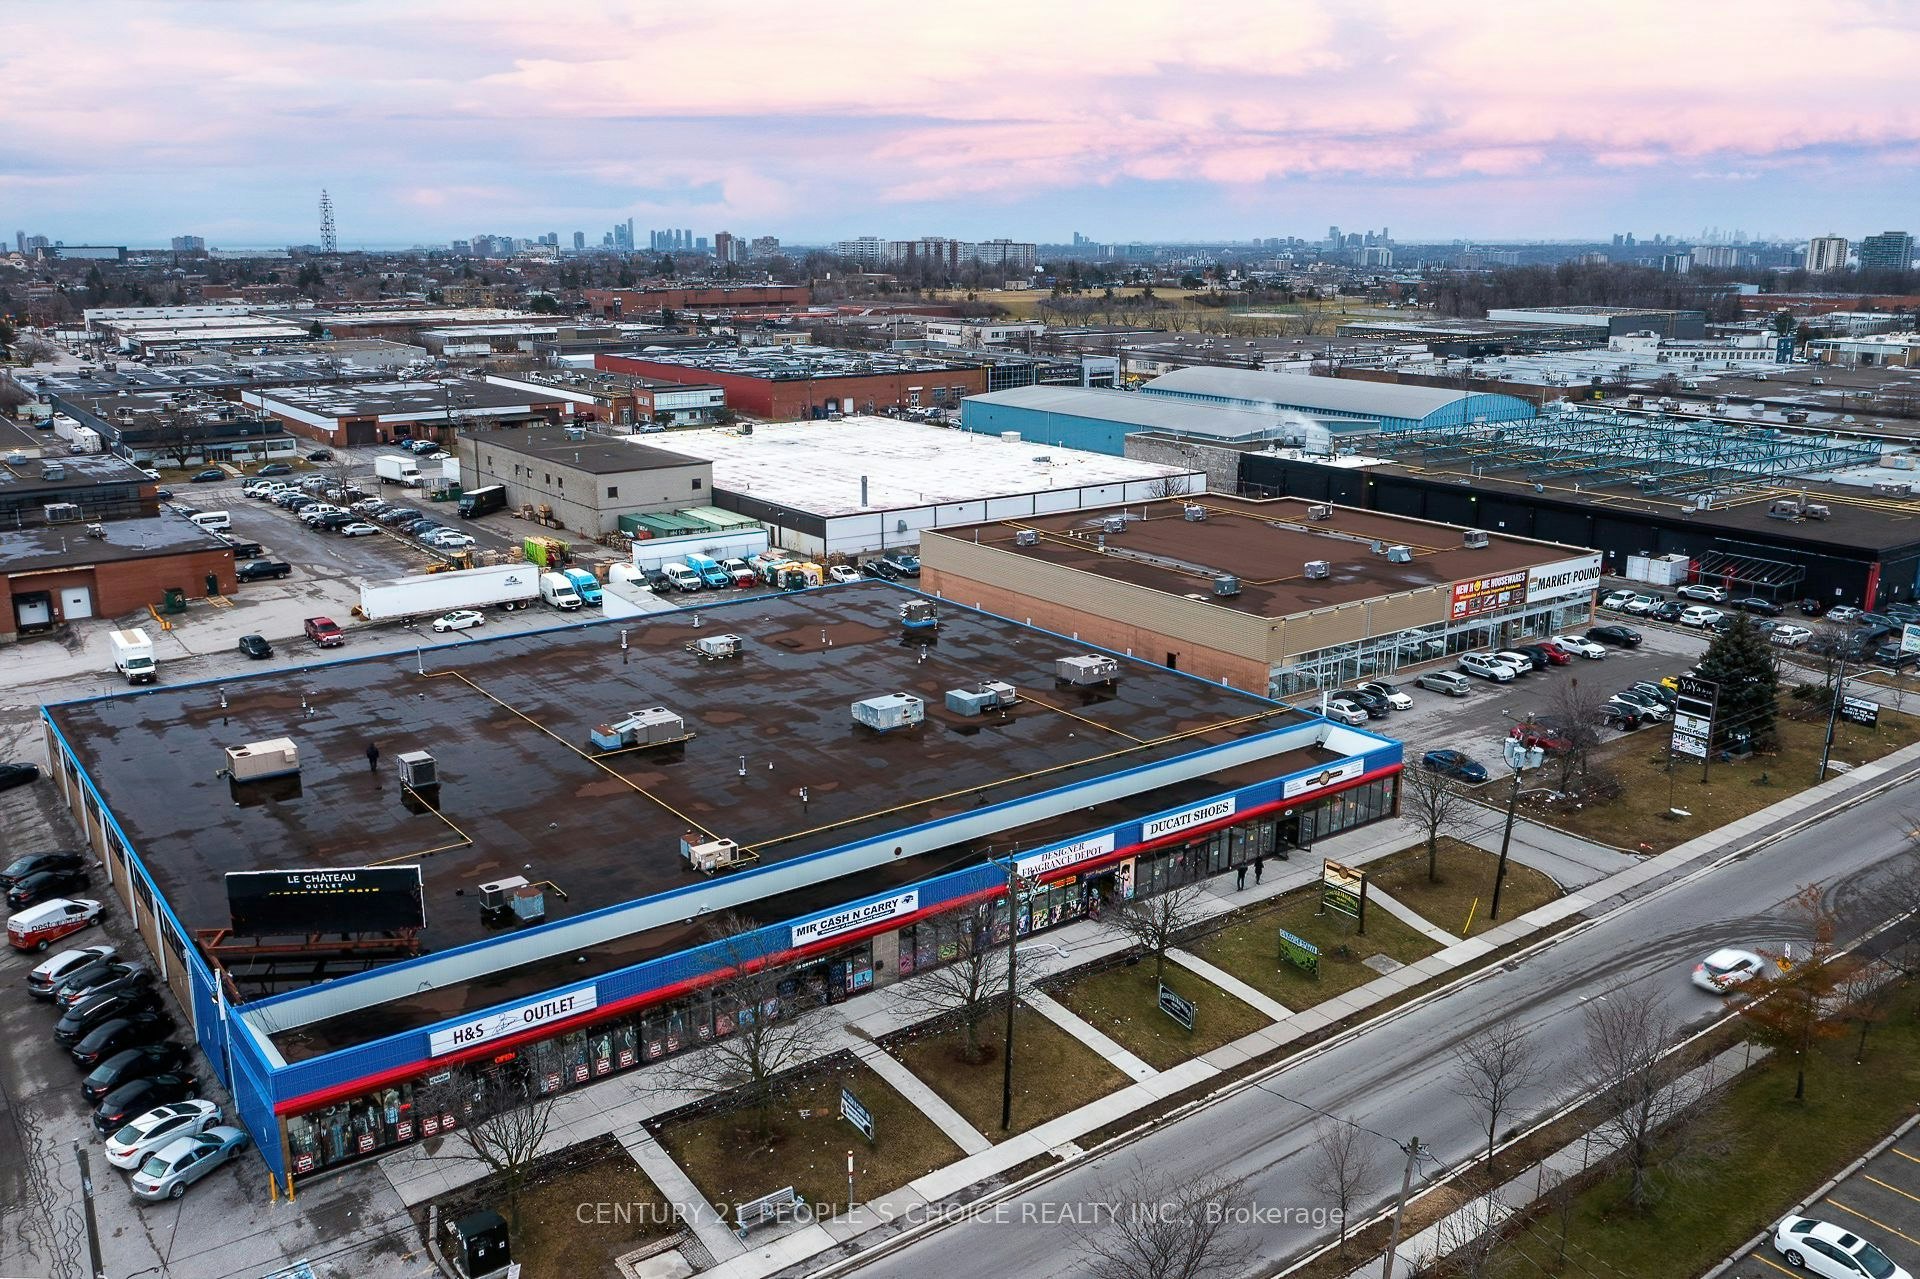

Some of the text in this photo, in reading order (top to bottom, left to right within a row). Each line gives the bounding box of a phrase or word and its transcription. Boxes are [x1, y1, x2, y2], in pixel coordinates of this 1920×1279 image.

[1456, 584, 1469, 595] NEW
[1491, 572, 1526, 589] HOUSEWARES
[1538, 572, 1571, 591] MARKET
[1573, 566, 1600, 583] POUND
[1150, 801, 1229, 835] DUCATI SHOES
[1022, 856, 1073, 877] FRAGRANCE
[1074, 845, 1103, 861] DEPOT
[1041, 842, 1085, 861] DESIGNER
[287, 875, 300, 884] LE
[796, 923, 817, 937] MIR
[820, 913, 849, 929] CASH
[852, 910, 861, 920] N
[863, 898, 899, 916] CARRY
[453, 1023, 484, 1045] H&S
[523, 996, 575, 1023] OUTLET
